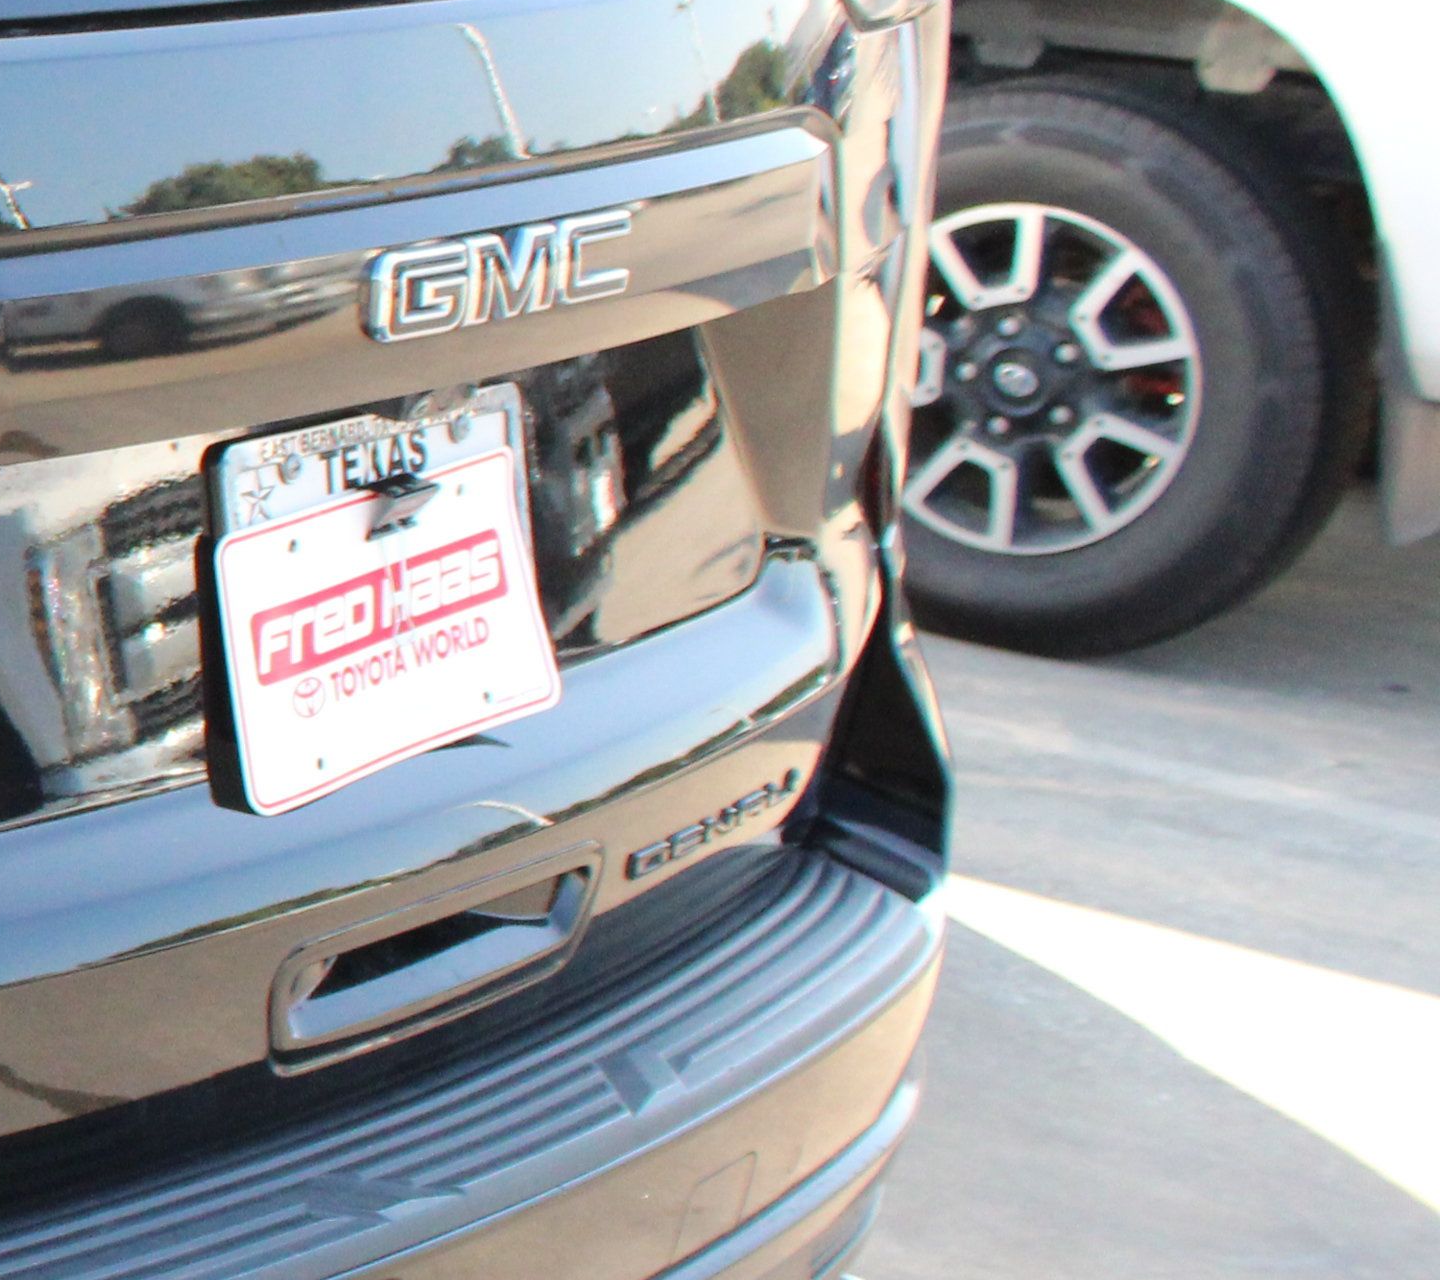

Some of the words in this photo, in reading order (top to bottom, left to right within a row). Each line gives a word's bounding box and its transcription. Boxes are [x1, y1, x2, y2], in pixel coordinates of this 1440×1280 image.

[365, 209, 632, 343] GMC
[318, 428, 428, 495] TEXAS
[330, 644, 407, 702] TOYOTA
[412, 616, 490, 668] WORLD
[624, 767, 800, 881] DENALI
